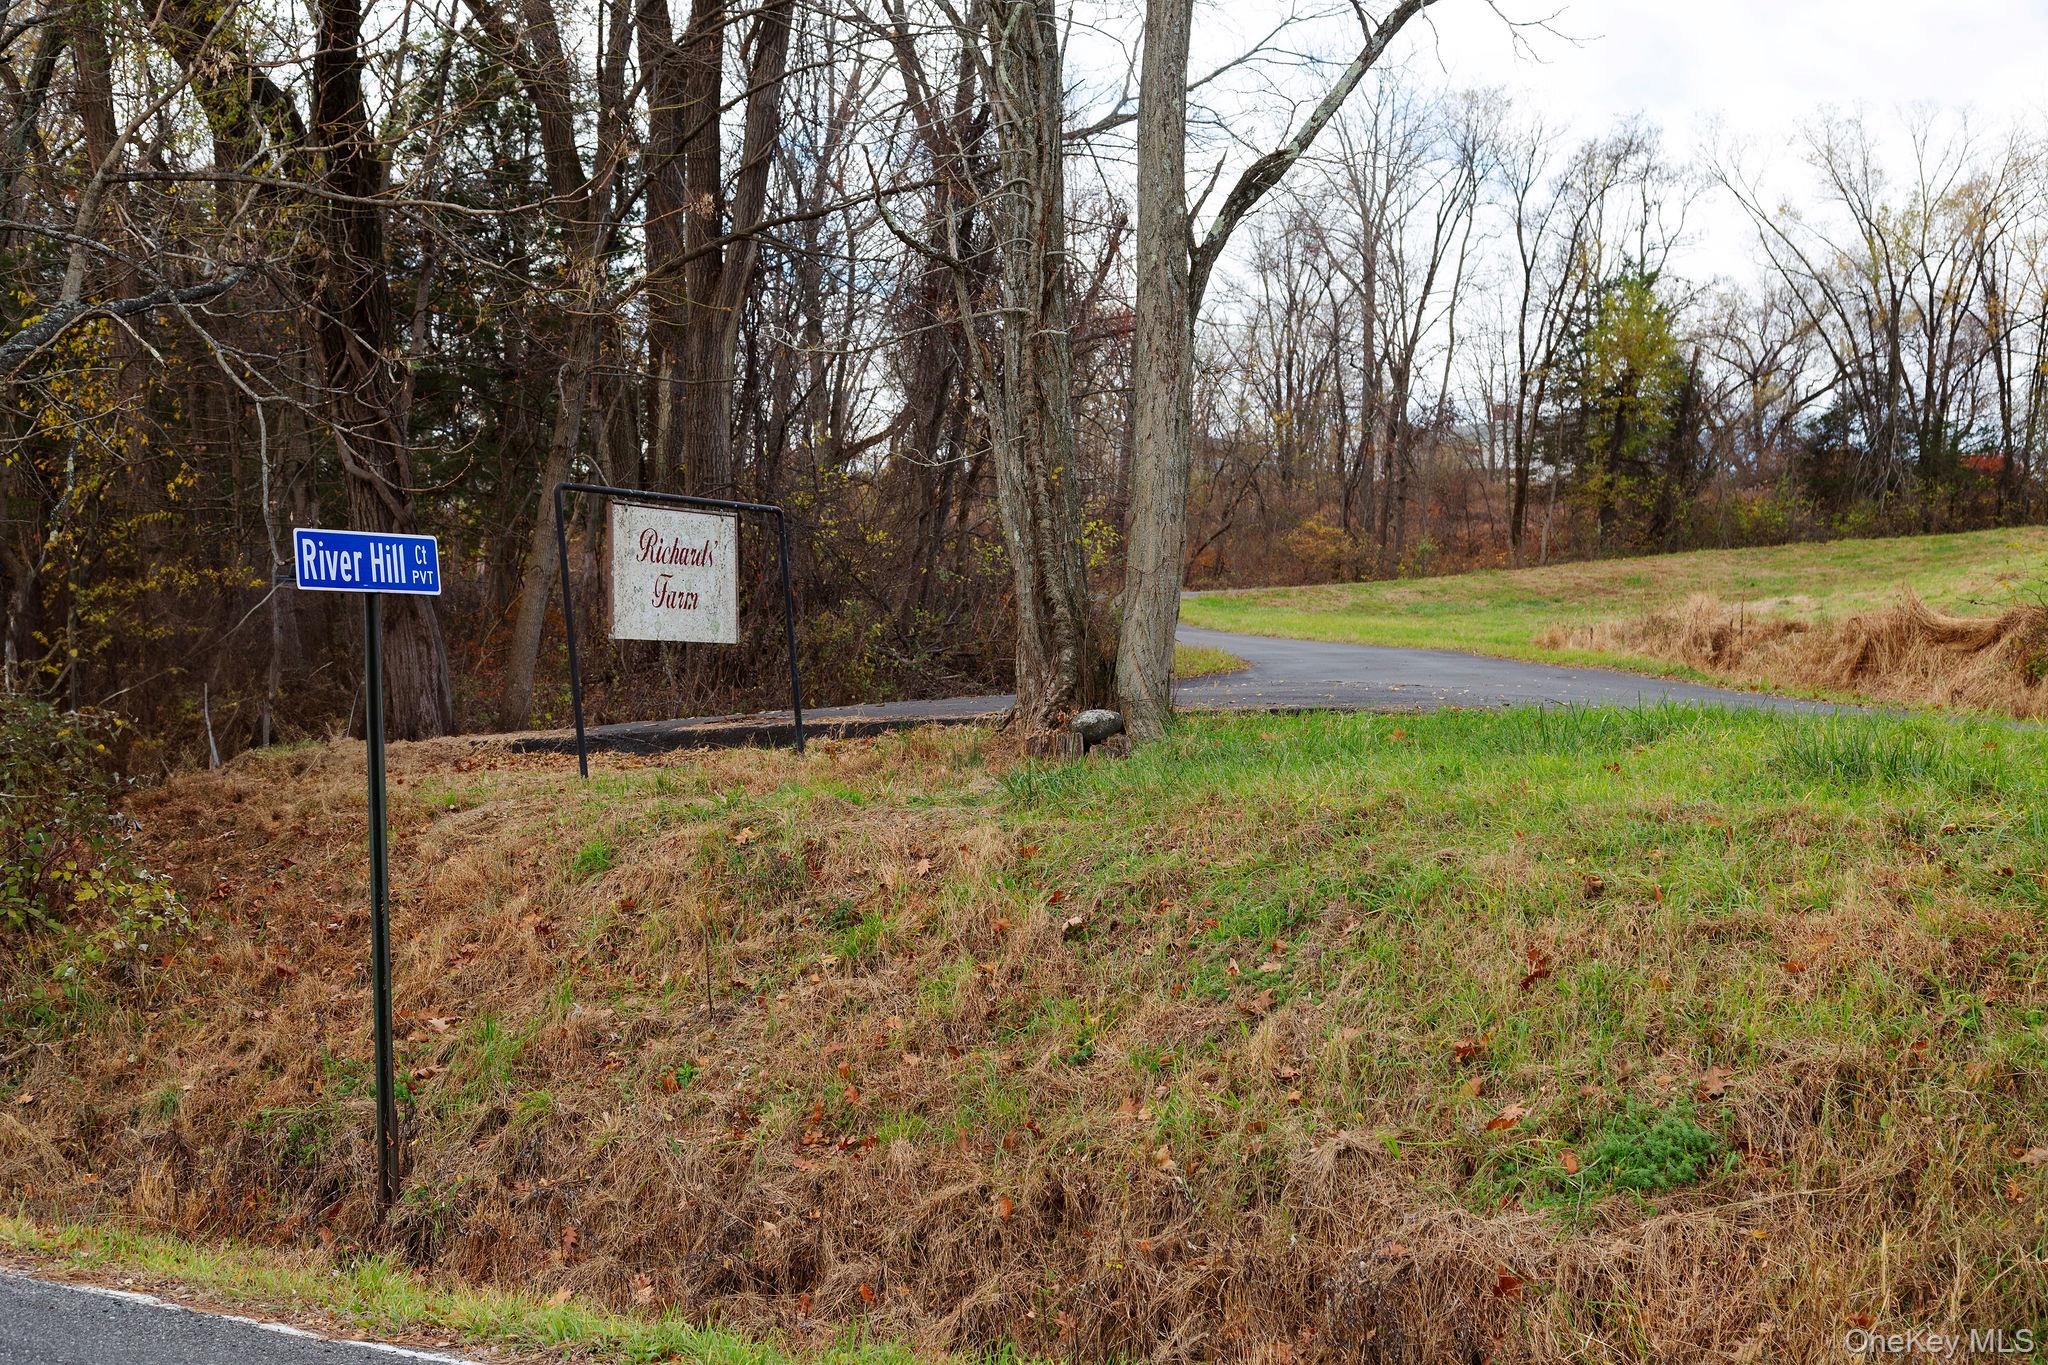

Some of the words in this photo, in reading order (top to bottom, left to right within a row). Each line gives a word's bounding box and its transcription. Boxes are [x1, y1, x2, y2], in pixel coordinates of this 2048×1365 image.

[302, 538, 362, 582] River
[369, 542, 406, 584] Hill
[415, 544, 427, 565] Ct
[636, 528, 718, 567] Richards'
[412, 570, 434, 585] PVT
[652, 573, 700, 610] Farm
